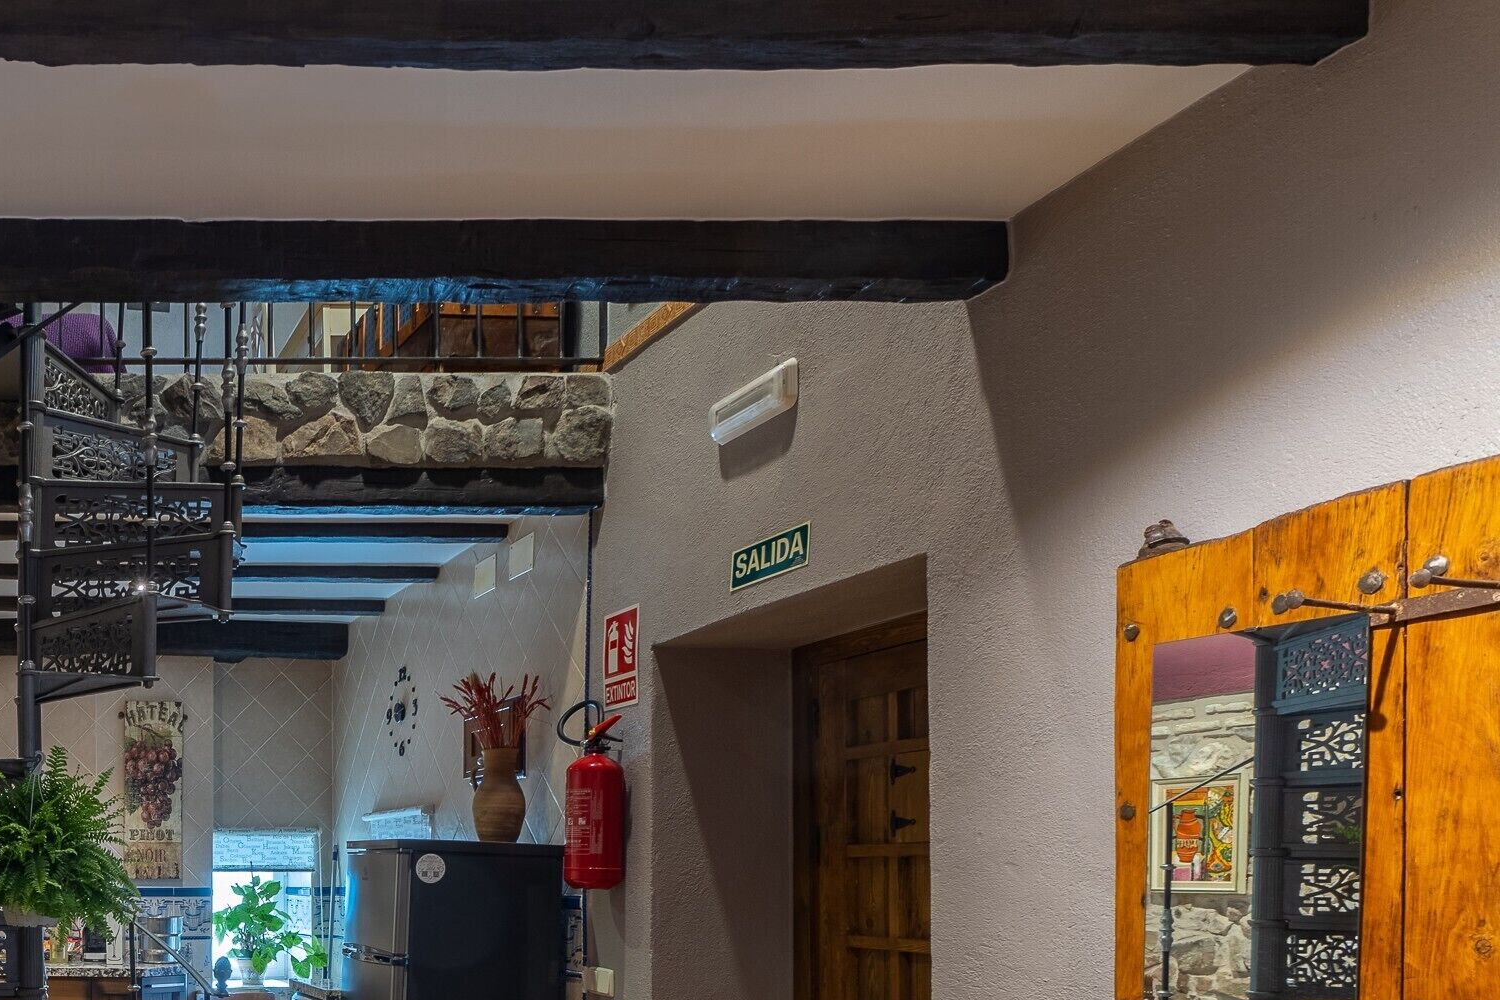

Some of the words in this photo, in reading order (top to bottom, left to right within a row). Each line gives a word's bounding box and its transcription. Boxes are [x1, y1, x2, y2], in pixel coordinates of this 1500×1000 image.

[735, 532, 804, 579] SALIDA
[398, 666, 407, 682] 12
[605, 680, 636, 704] EXTINTOR
[386, 708, 393, 725] 9
[412, 699, 418, 717] 3
[399, 740, 405, 757] 6
[129, 829, 175, 841] PINOT
[136, 848, 166, 863] NOIR
